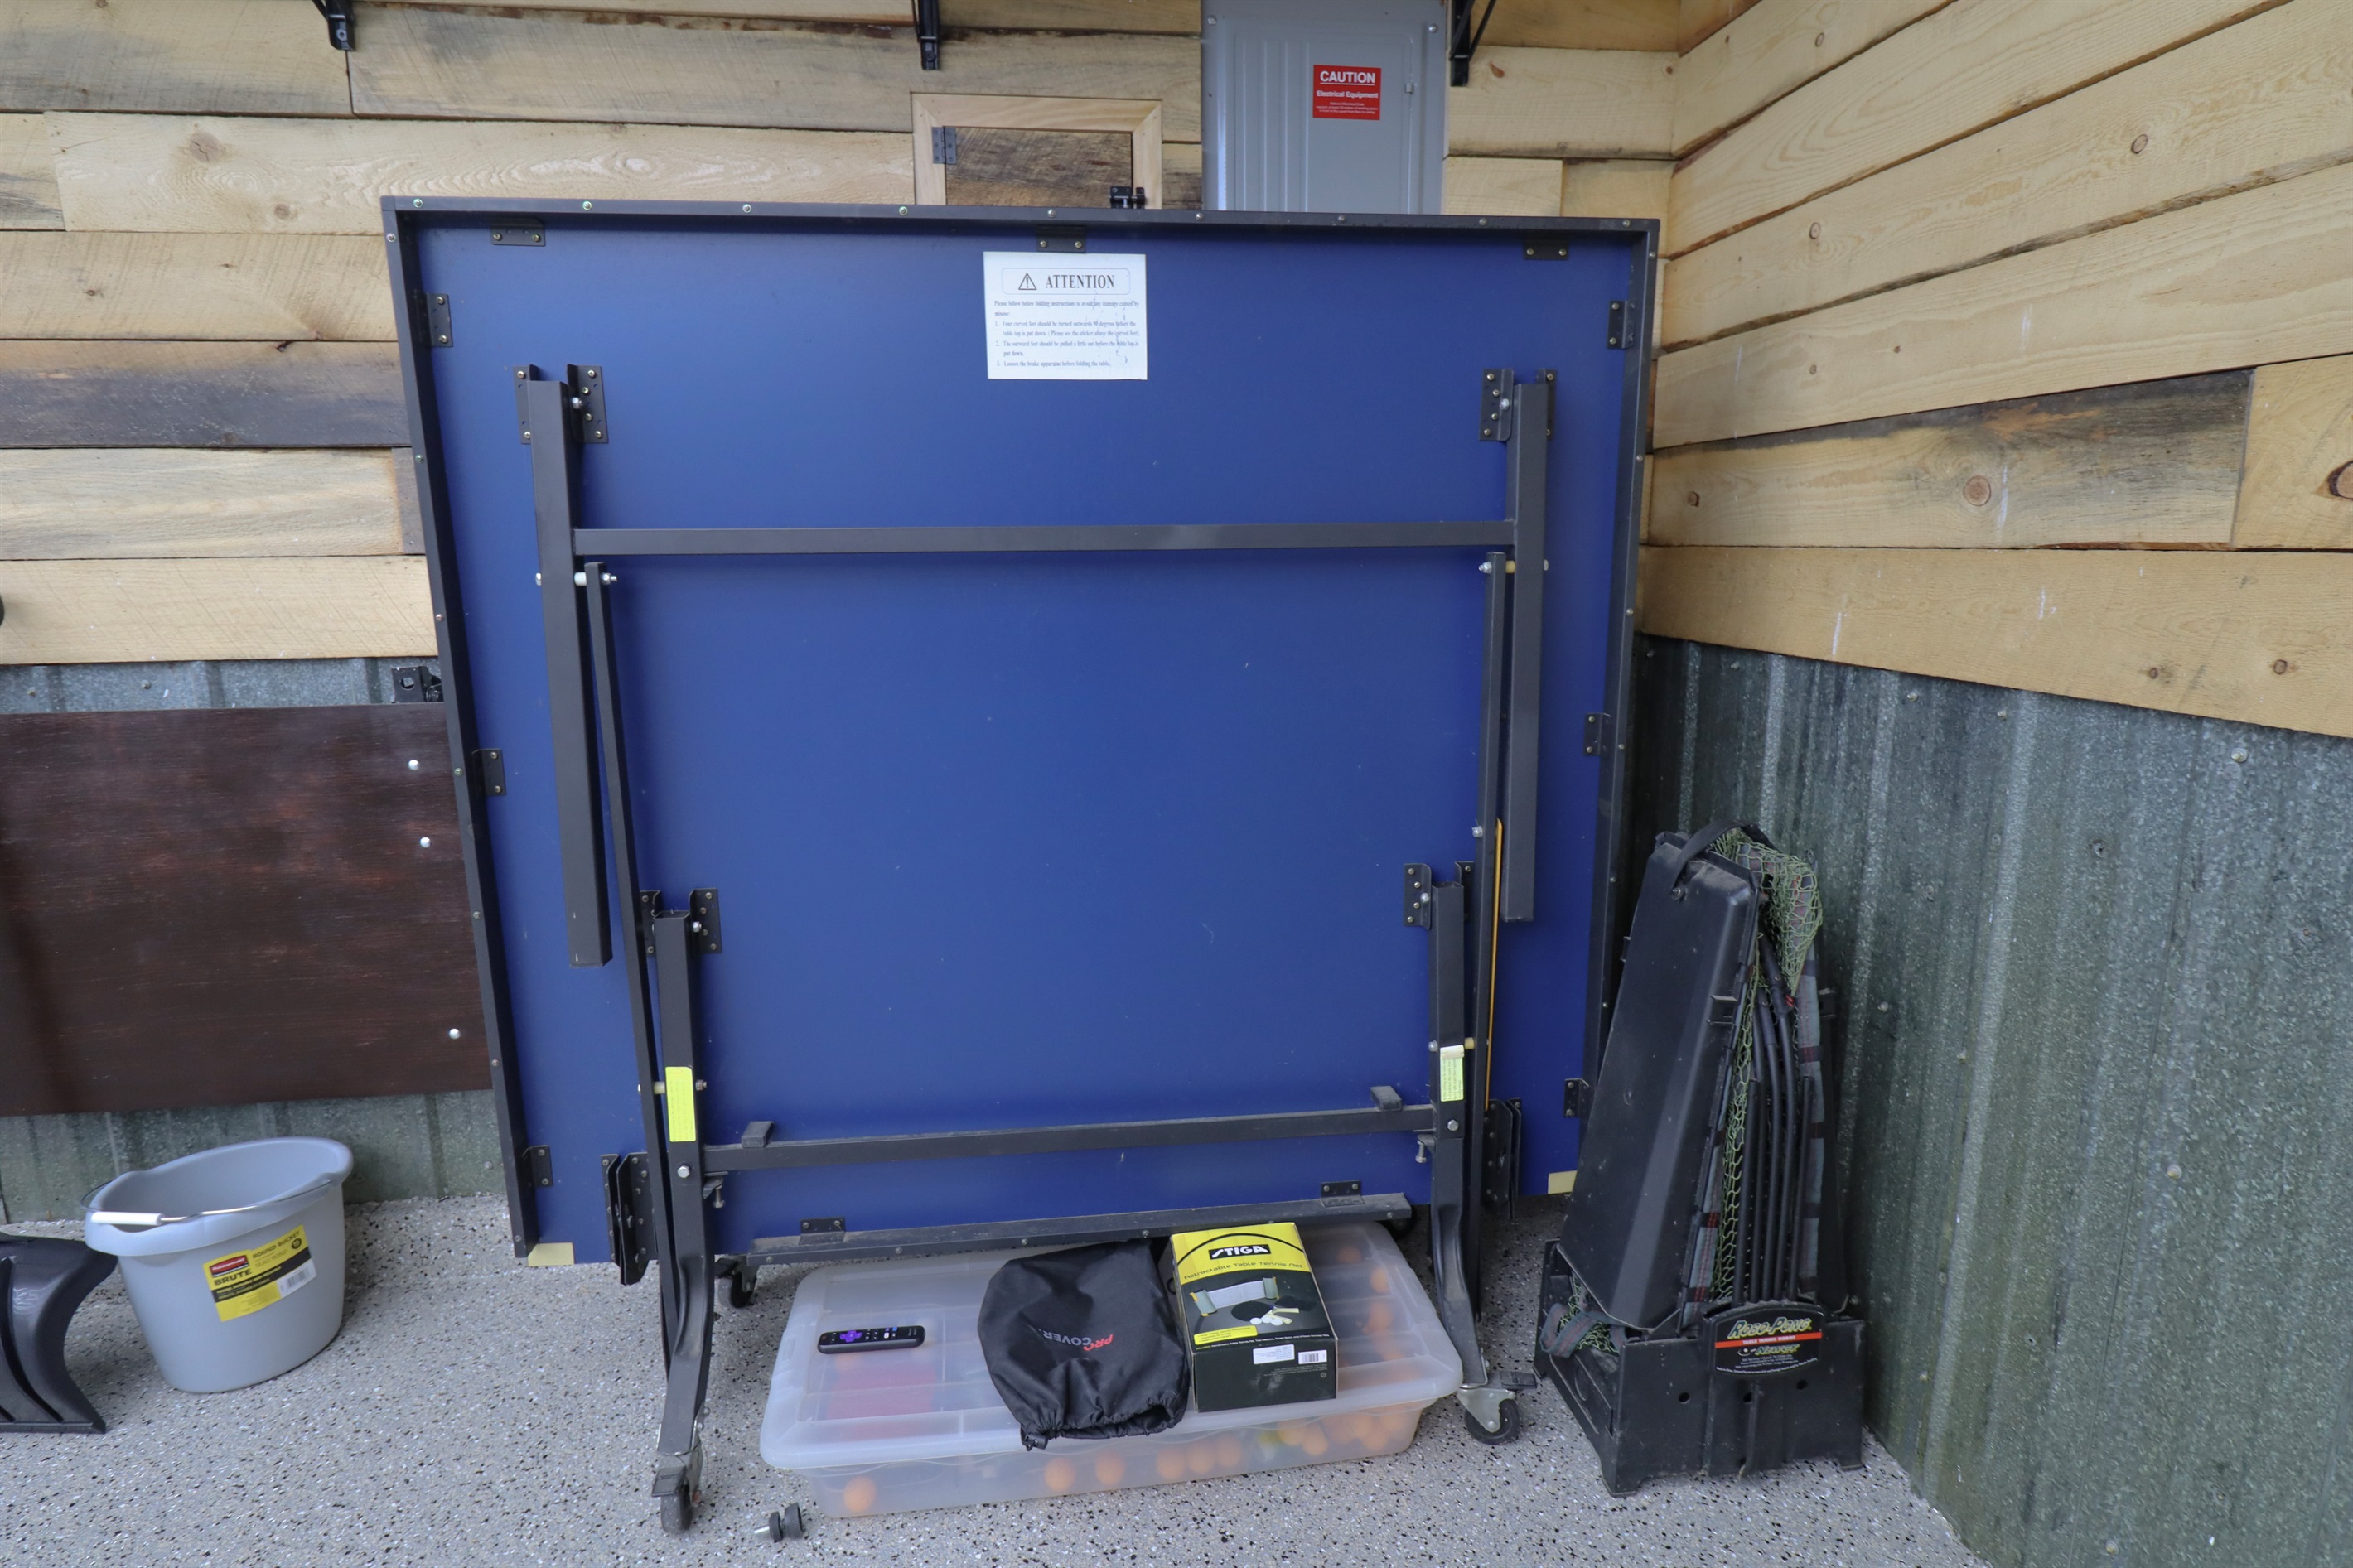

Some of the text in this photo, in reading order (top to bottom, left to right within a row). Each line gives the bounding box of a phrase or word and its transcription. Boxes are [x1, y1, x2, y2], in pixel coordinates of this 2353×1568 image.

[1320, 70, 1375, 83] CAUTION
[1046, 275, 1114, 288] ATTENTION
[252, 1245, 277, 1258] ROUND
[278, 1231, 300, 1247] BUCKET
[1212, 1246, 1268, 1258] STIGA
[214, 1268, 252, 1286] BRUTE
[1184, 1265, 1231, 1280] Retractable
[1083, 1334, 1114, 1352] PRO
